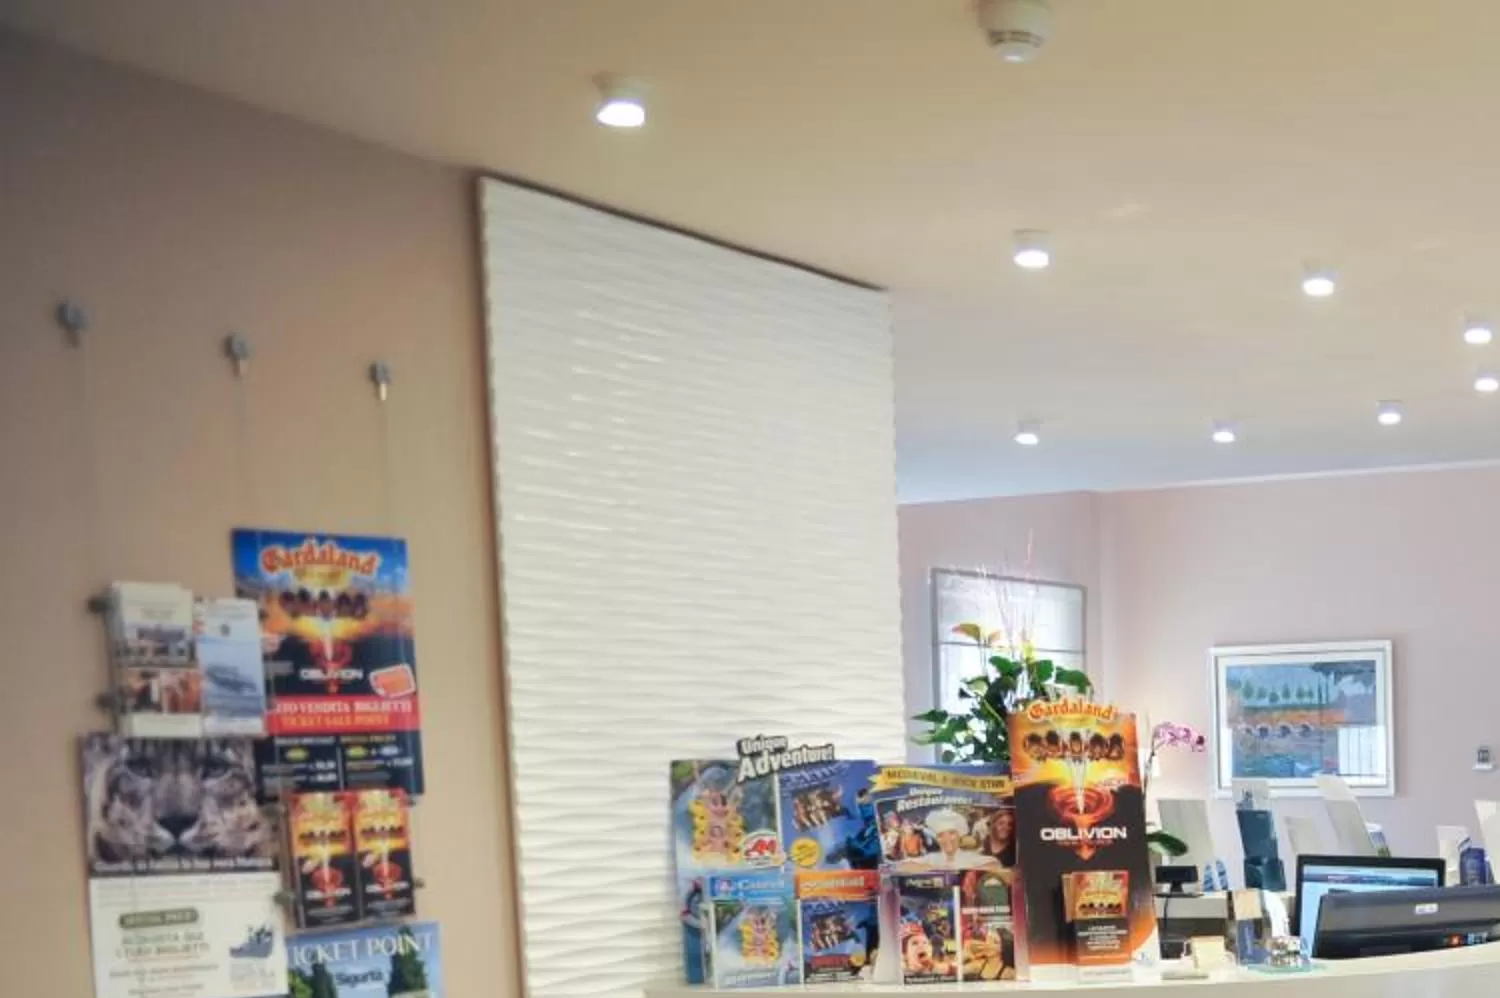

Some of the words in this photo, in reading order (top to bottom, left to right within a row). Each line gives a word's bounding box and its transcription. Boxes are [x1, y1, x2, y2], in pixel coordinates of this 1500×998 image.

[1027, 698, 1115, 721] Gardaland
[1040, 826, 1128, 841] OBLIVION
[292, 939, 362, 966] ICKET
[366, 931, 434, 957] POINT
